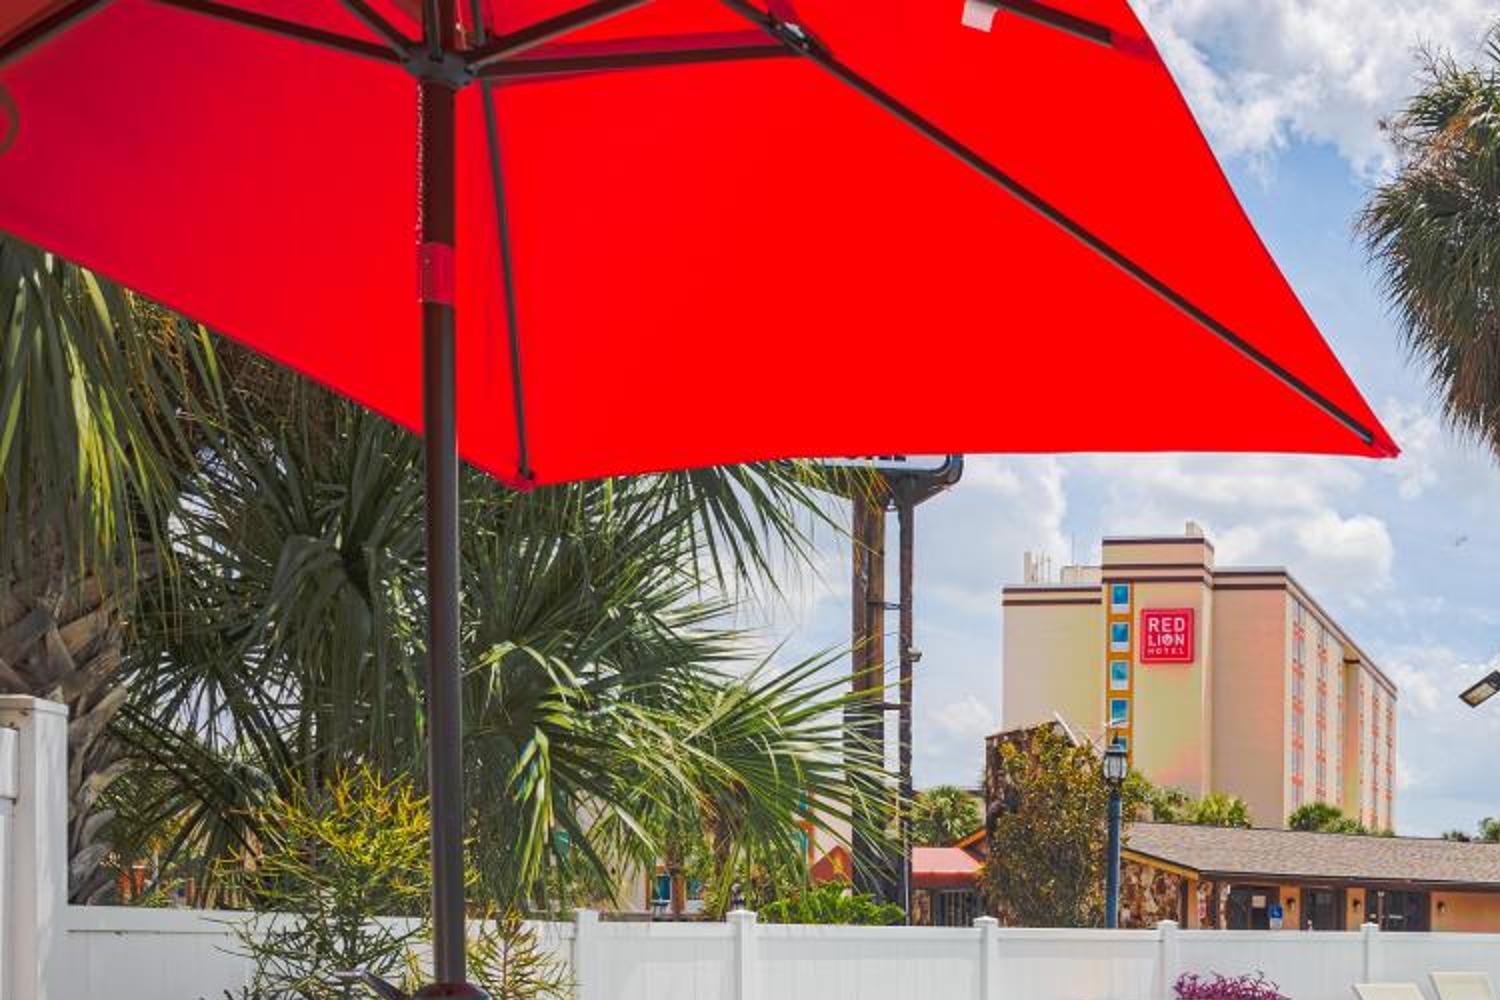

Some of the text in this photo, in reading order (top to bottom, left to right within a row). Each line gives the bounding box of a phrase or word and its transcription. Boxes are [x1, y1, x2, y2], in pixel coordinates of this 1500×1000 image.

[1148, 617, 1185, 632] RED
[1148, 634, 1185, 646] LION
[1148, 647, 1184, 655] HOTEL
